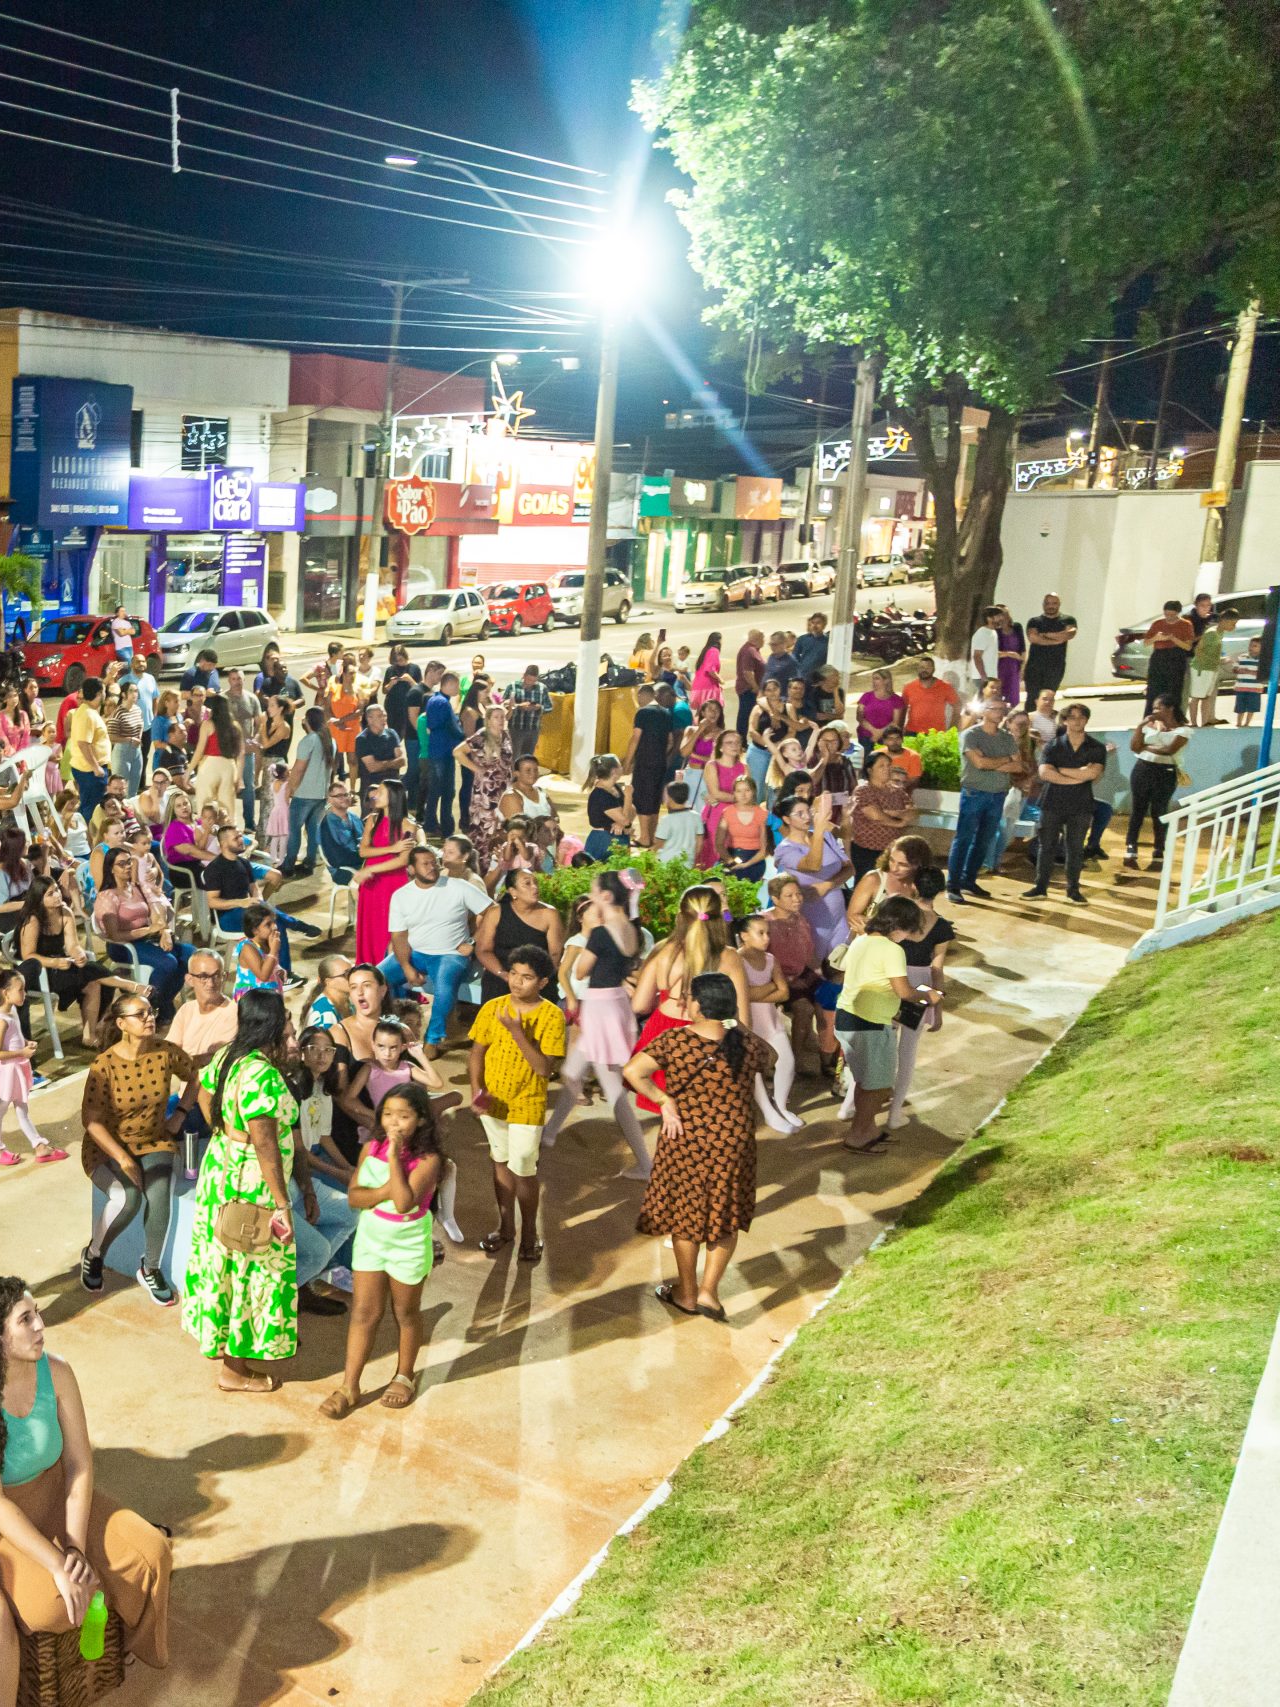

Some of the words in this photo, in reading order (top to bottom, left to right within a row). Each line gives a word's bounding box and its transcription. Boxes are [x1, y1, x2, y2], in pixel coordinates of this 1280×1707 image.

[51, 456, 122, 475] LABORAT
[396, 484, 424, 502] Sabor
[518, 491, 570, 516] GOIÁS
